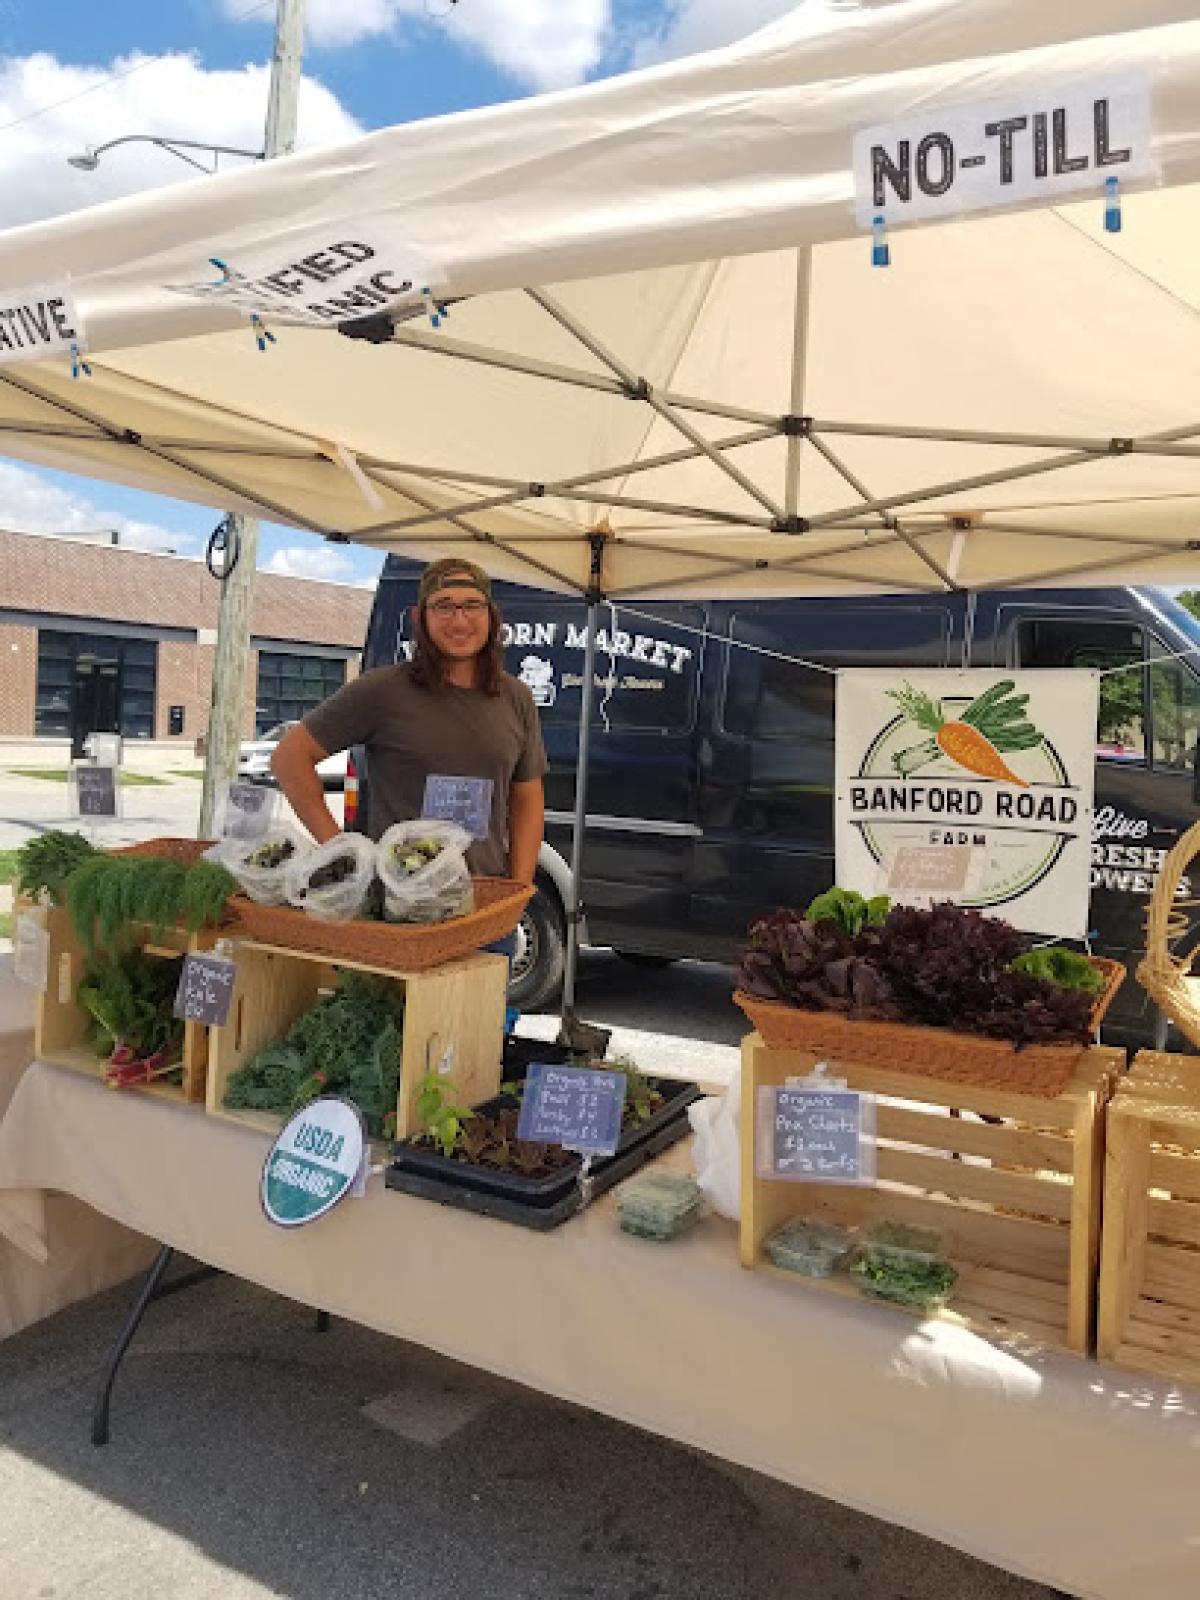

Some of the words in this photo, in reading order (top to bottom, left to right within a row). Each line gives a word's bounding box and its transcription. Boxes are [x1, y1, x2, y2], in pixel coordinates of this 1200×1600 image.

[870, 98, 1133, 207] NO-TILL
[564, 622, 693, 675] MARKET
[851, 786, 983, 816] BANFORD
[996, 790, 1078, 824] ROAD
[1091, 844, 1169, 871] RESH
[293, 1122, 345, 1163] USDA
